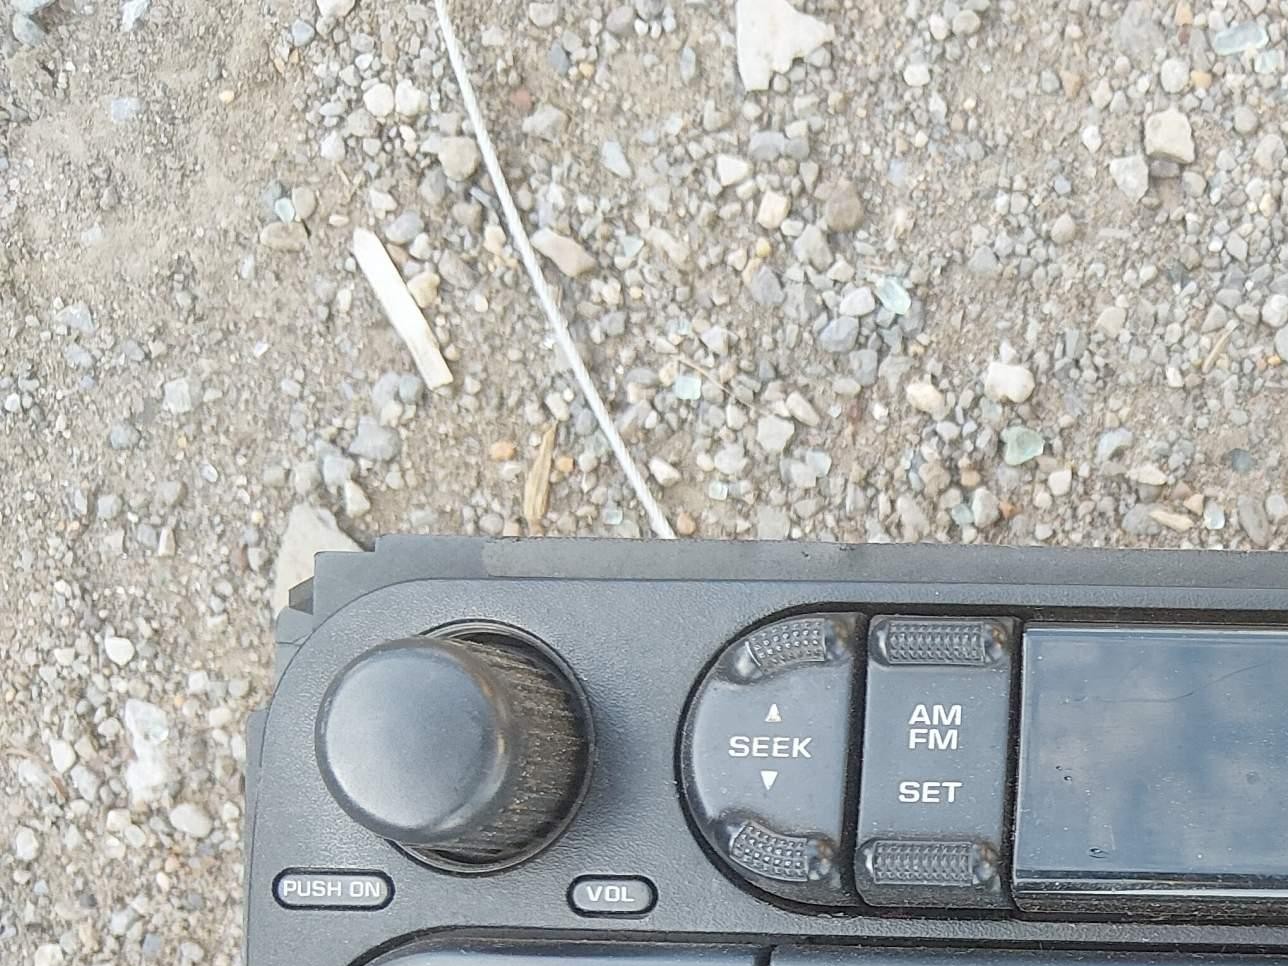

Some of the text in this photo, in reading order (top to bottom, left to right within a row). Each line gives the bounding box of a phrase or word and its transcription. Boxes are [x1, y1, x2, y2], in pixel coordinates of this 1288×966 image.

[907, 703, 963, 726] AM
[728, 735, 812, 758] SEEK
[909, 728, 958, 750] FM
[898, 781, 962, 803] SET
[283, 879, 380, 897] PUSH ON
[586, 885, 635, 902] VOL
